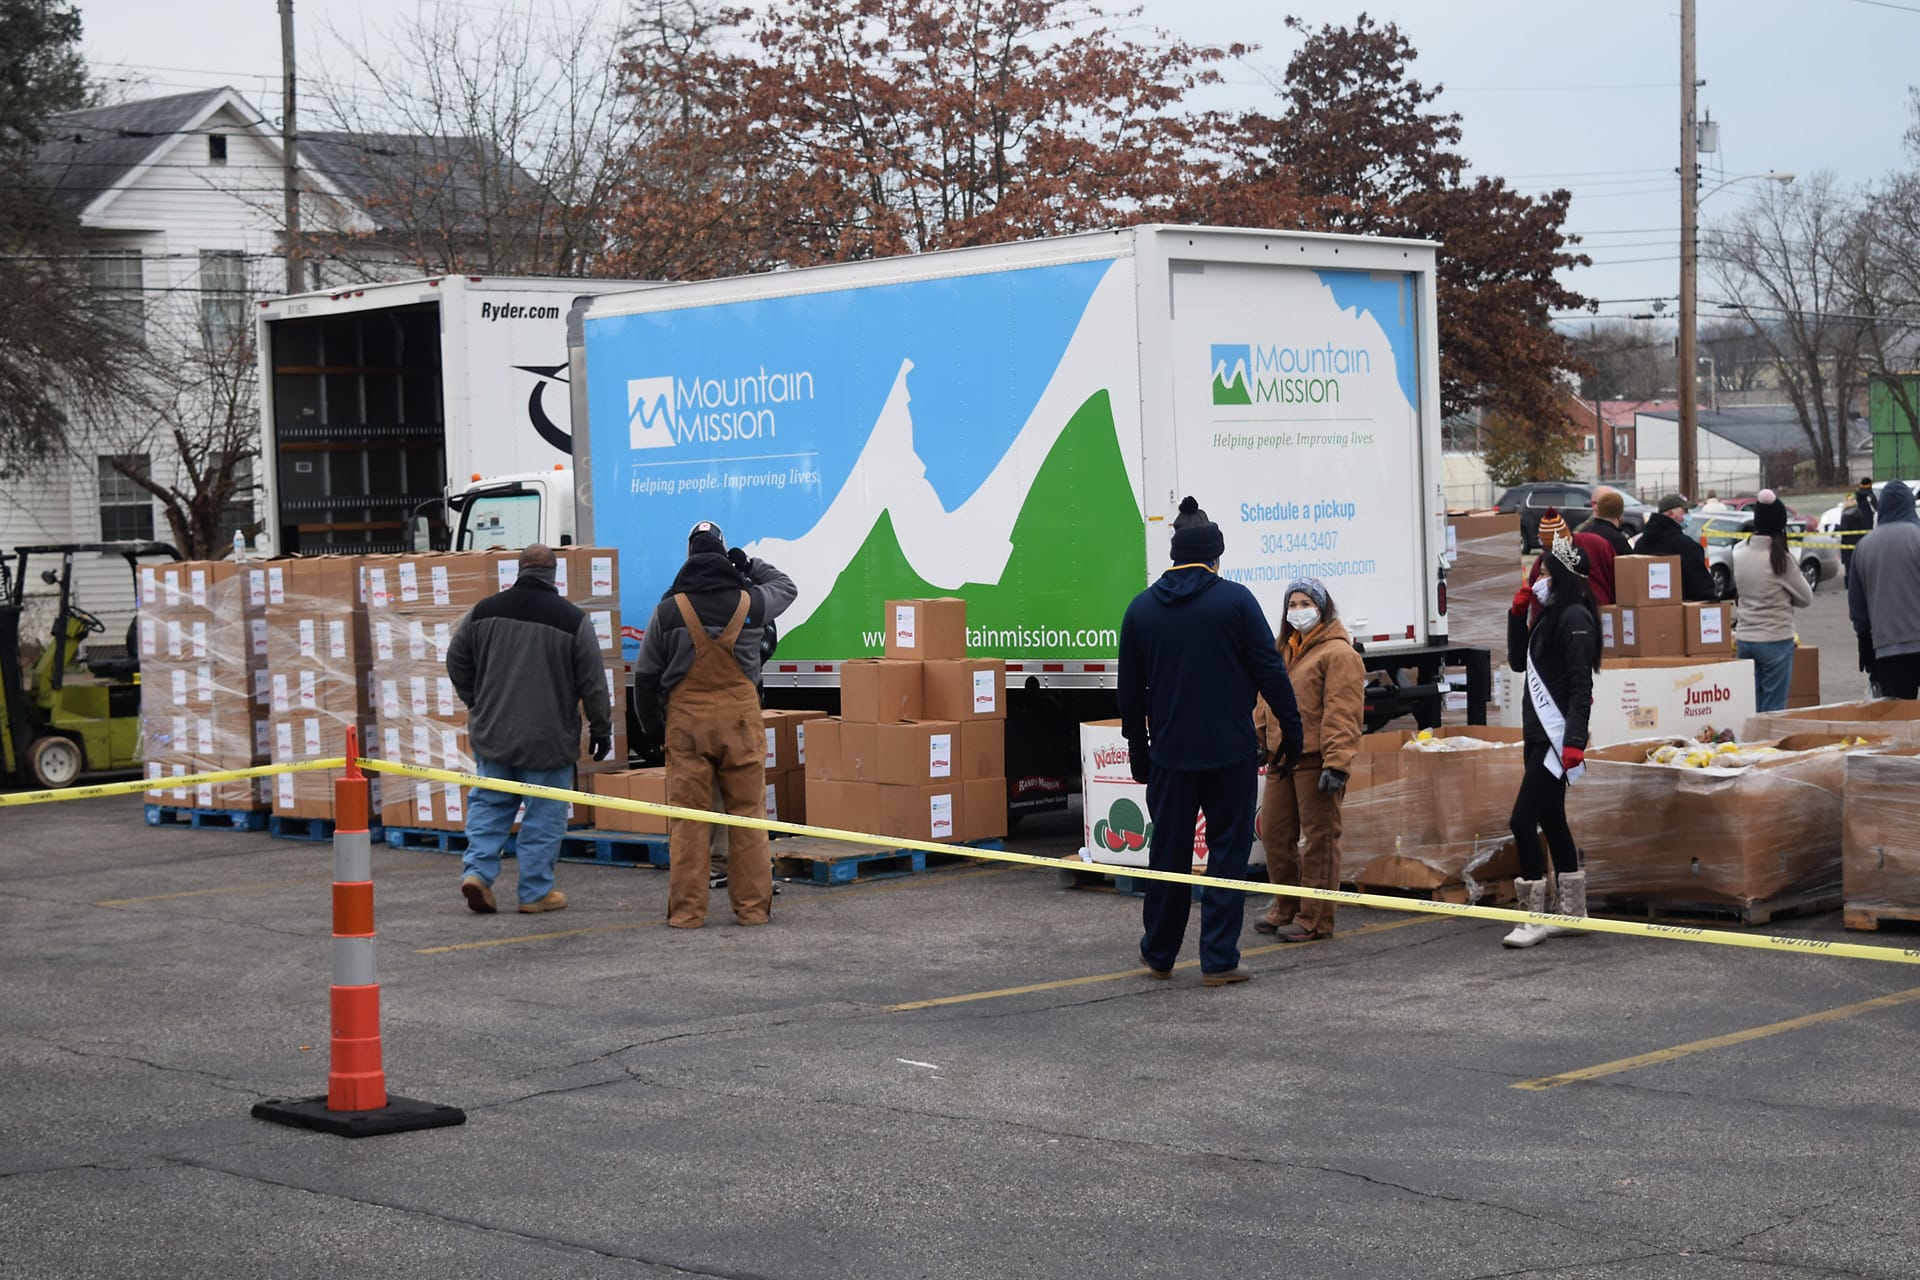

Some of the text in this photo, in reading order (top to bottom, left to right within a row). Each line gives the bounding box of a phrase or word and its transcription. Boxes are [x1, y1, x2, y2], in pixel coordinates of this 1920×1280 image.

[481, 302, 560, 322] Ryder.com
[1256, 341, 1371, 374] Mountain
[677, 365, 815, 409] Mountain
[1256, 377, 1340, 403] Mission
[677, 408, 776, 444] Mission
[1213, 431, 1376, 450] Helping people. Improving lives.
[631, 468, 821, 495] Helping people. Improving lives.
[1241, 500, 1356, 522] Schedule a pickup
[1261, 531, 1338, 554] 304.344.3407
[863, 625, 1117, 648] wwtainmission.com
[1684, 683, 1731, 705] Jumbo
[1684, 706, 1712, 717] Russets
